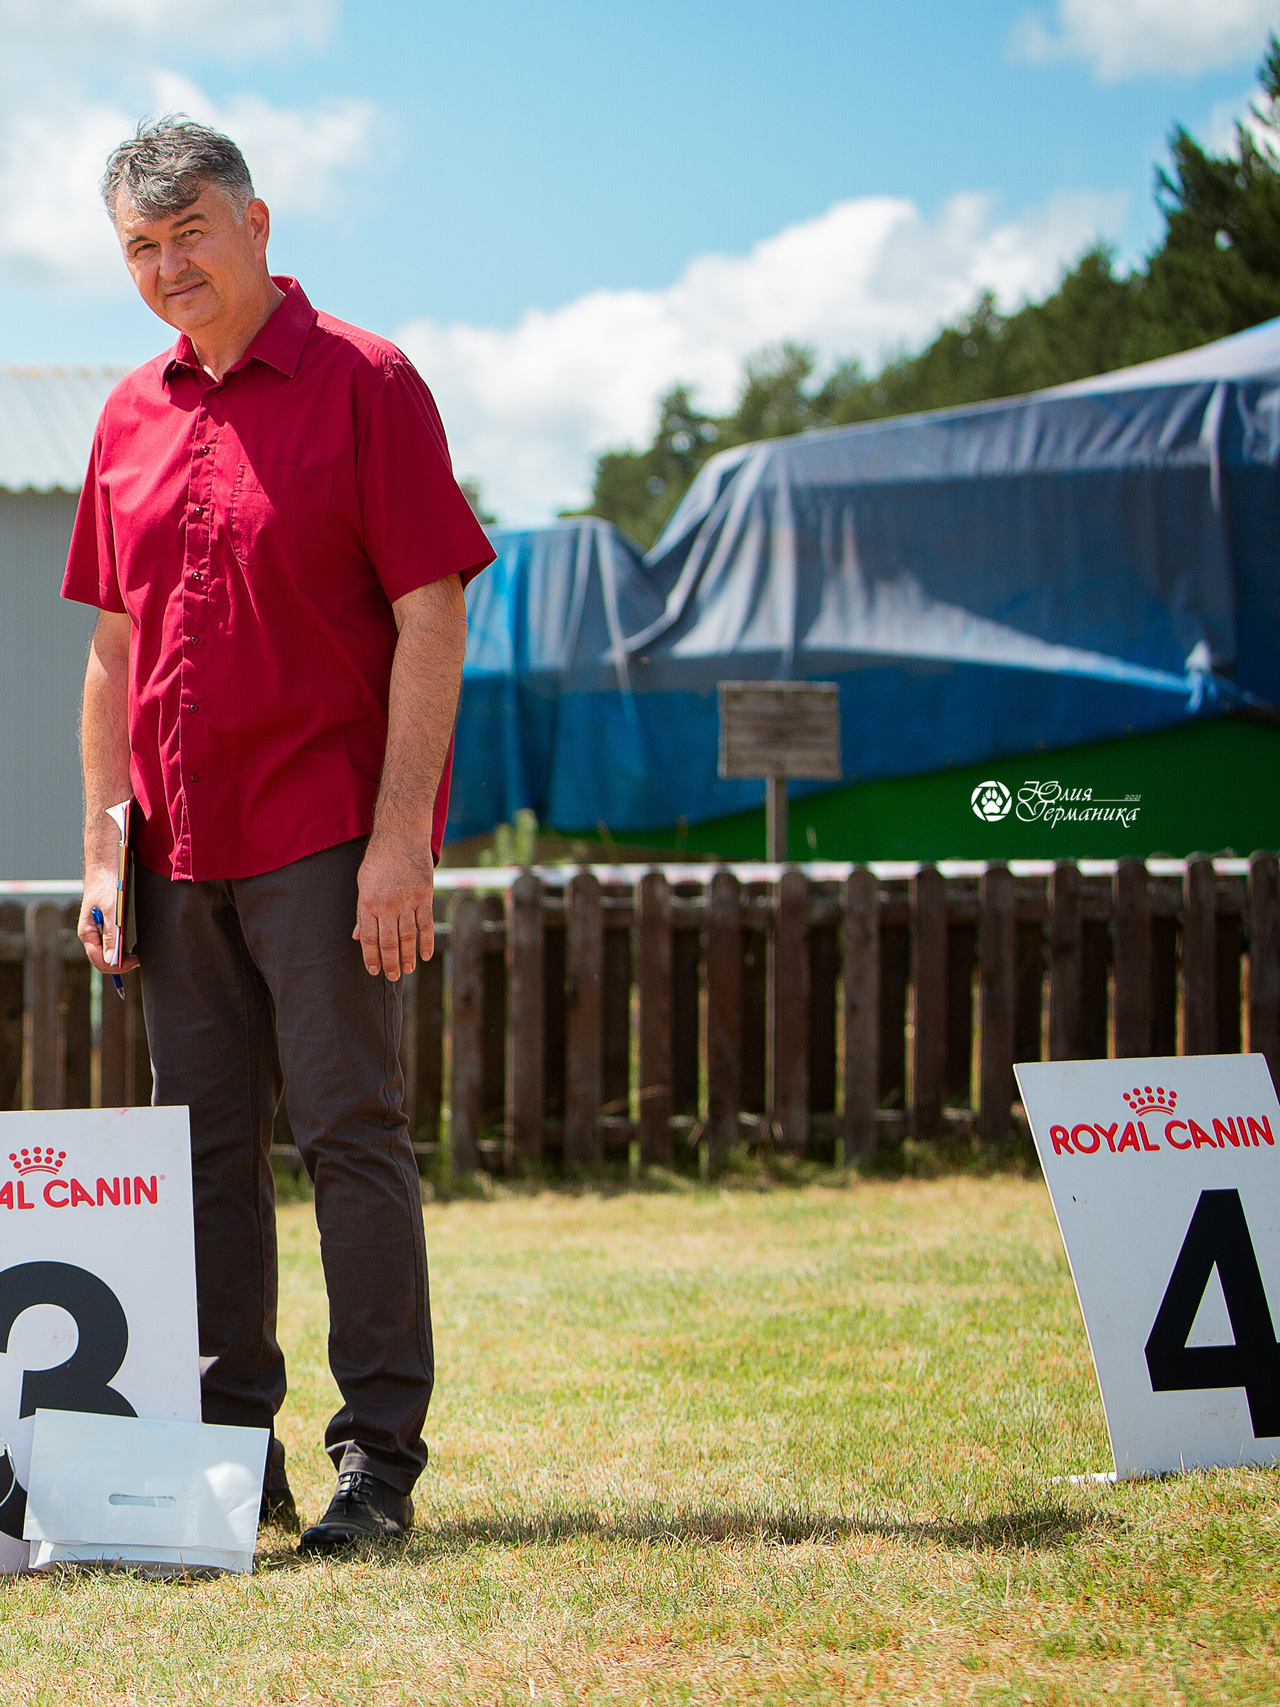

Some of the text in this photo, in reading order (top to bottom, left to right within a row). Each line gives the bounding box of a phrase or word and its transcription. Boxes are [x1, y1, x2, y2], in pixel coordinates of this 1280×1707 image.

[1049, 1115, 1275, 1155] ROYAL CANIN
[1144, 1188, 1280, 1438] 4
